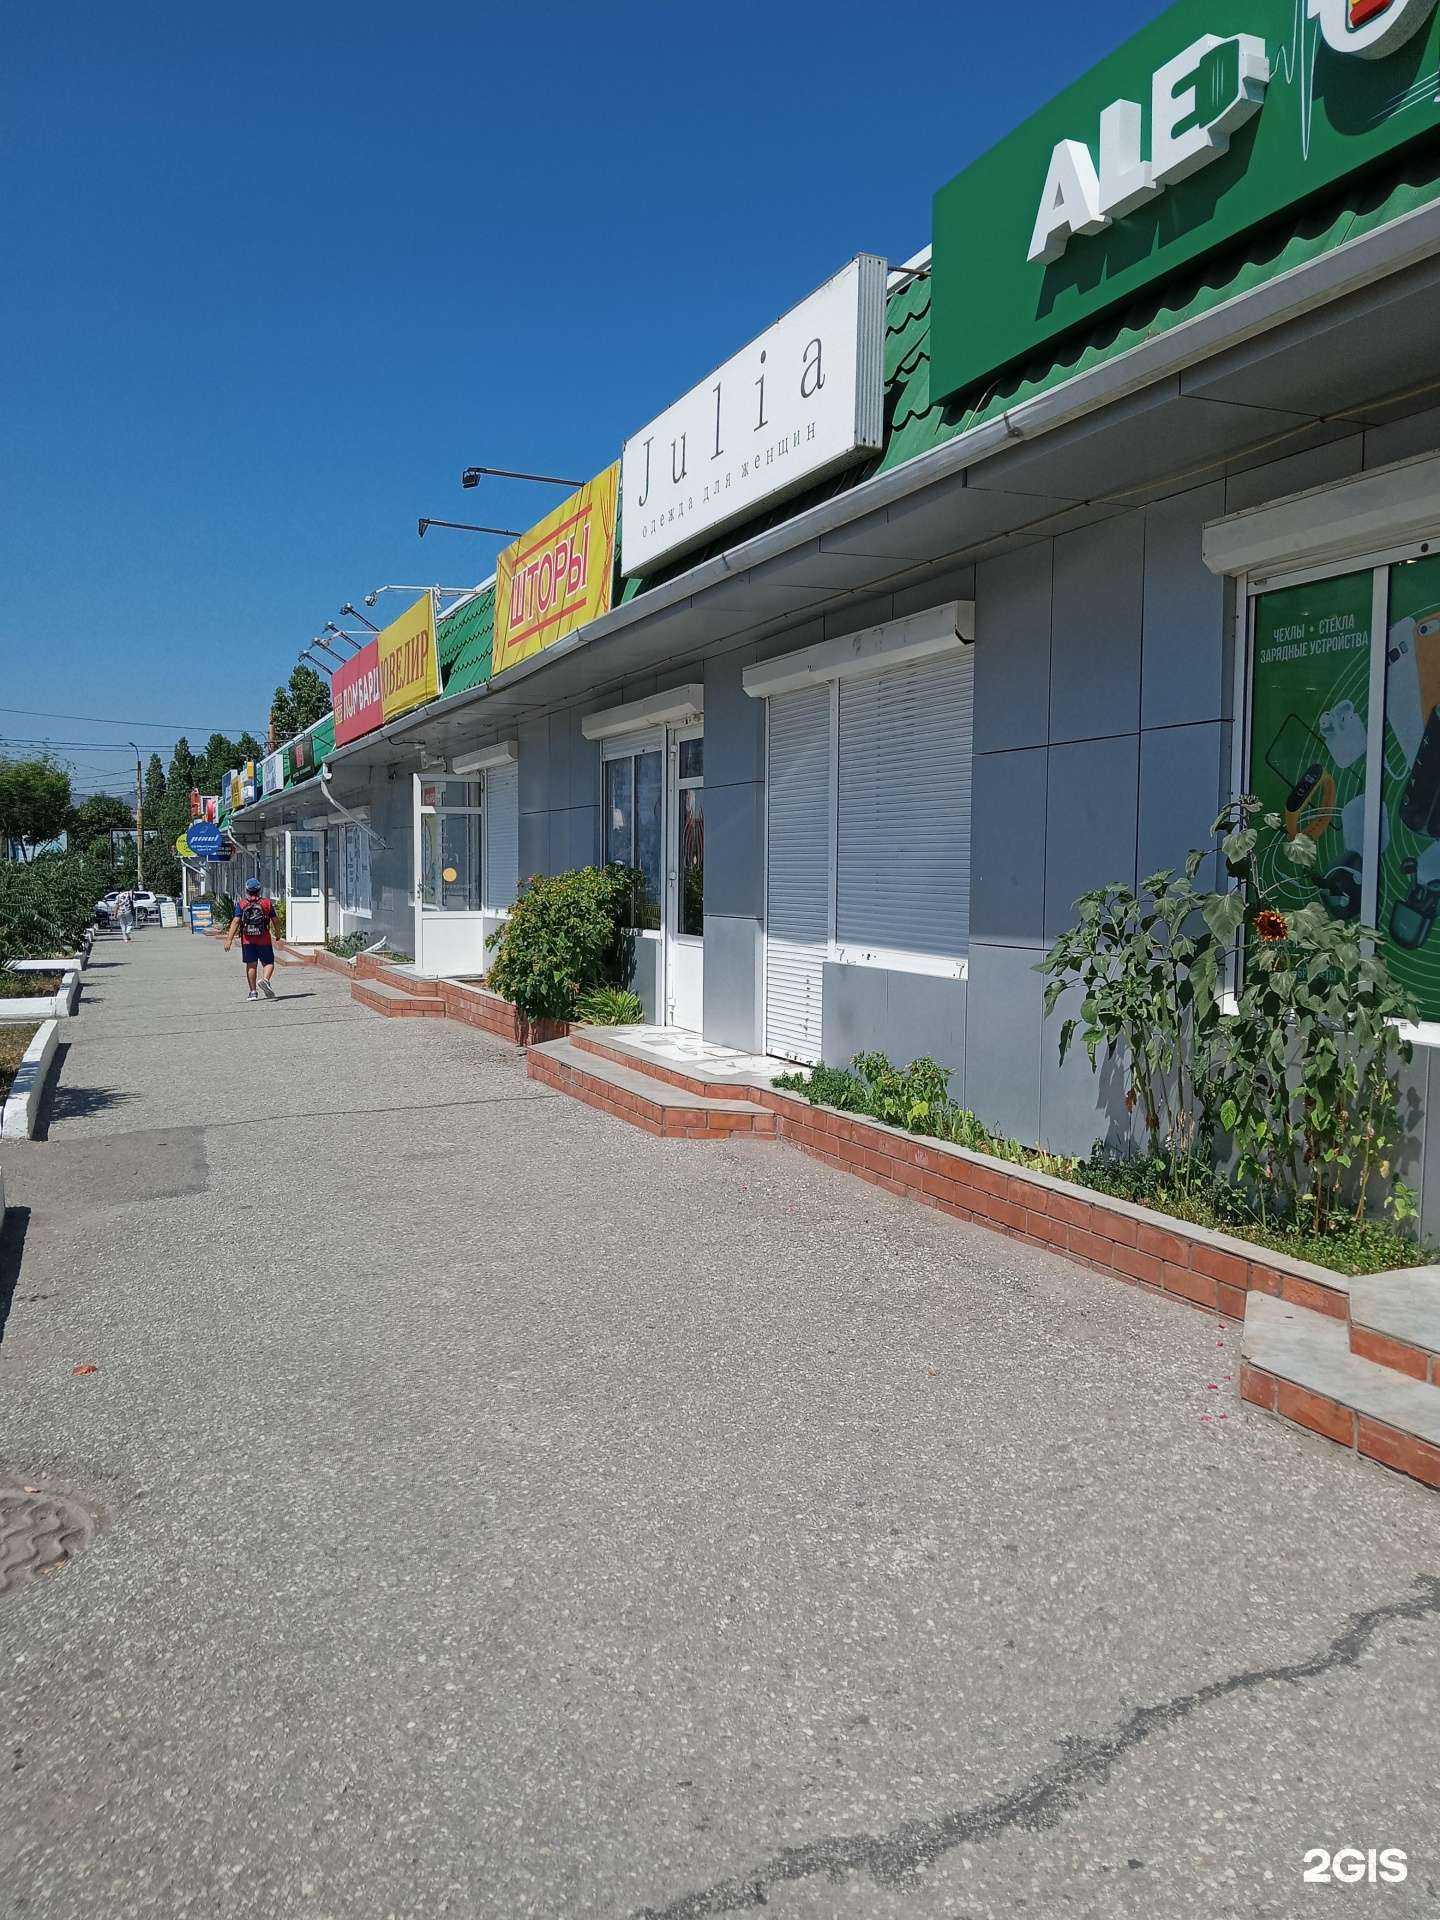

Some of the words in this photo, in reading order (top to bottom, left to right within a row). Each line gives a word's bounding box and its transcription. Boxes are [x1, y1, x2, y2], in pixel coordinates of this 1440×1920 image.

[638, 337, 826, 507] Julia
[642, 496, 694, 538] одежда
[702, 472, 731, 504] для
[741, 422, 816, 479] женщин
[509, 523, 590, 632] ШТОРЫ
[1260, 641, 1309, 664] ЗАРЯДНЫЕ
[1310, 630, 1370, 655] УСТРОЙСТВА
[1273, 623, 1306, 643] ЧЕХЛЫ
[1319, 613, 1356, 635] СТЕКЛА
[342, 665, 381, 721] ЛОМБАРД
